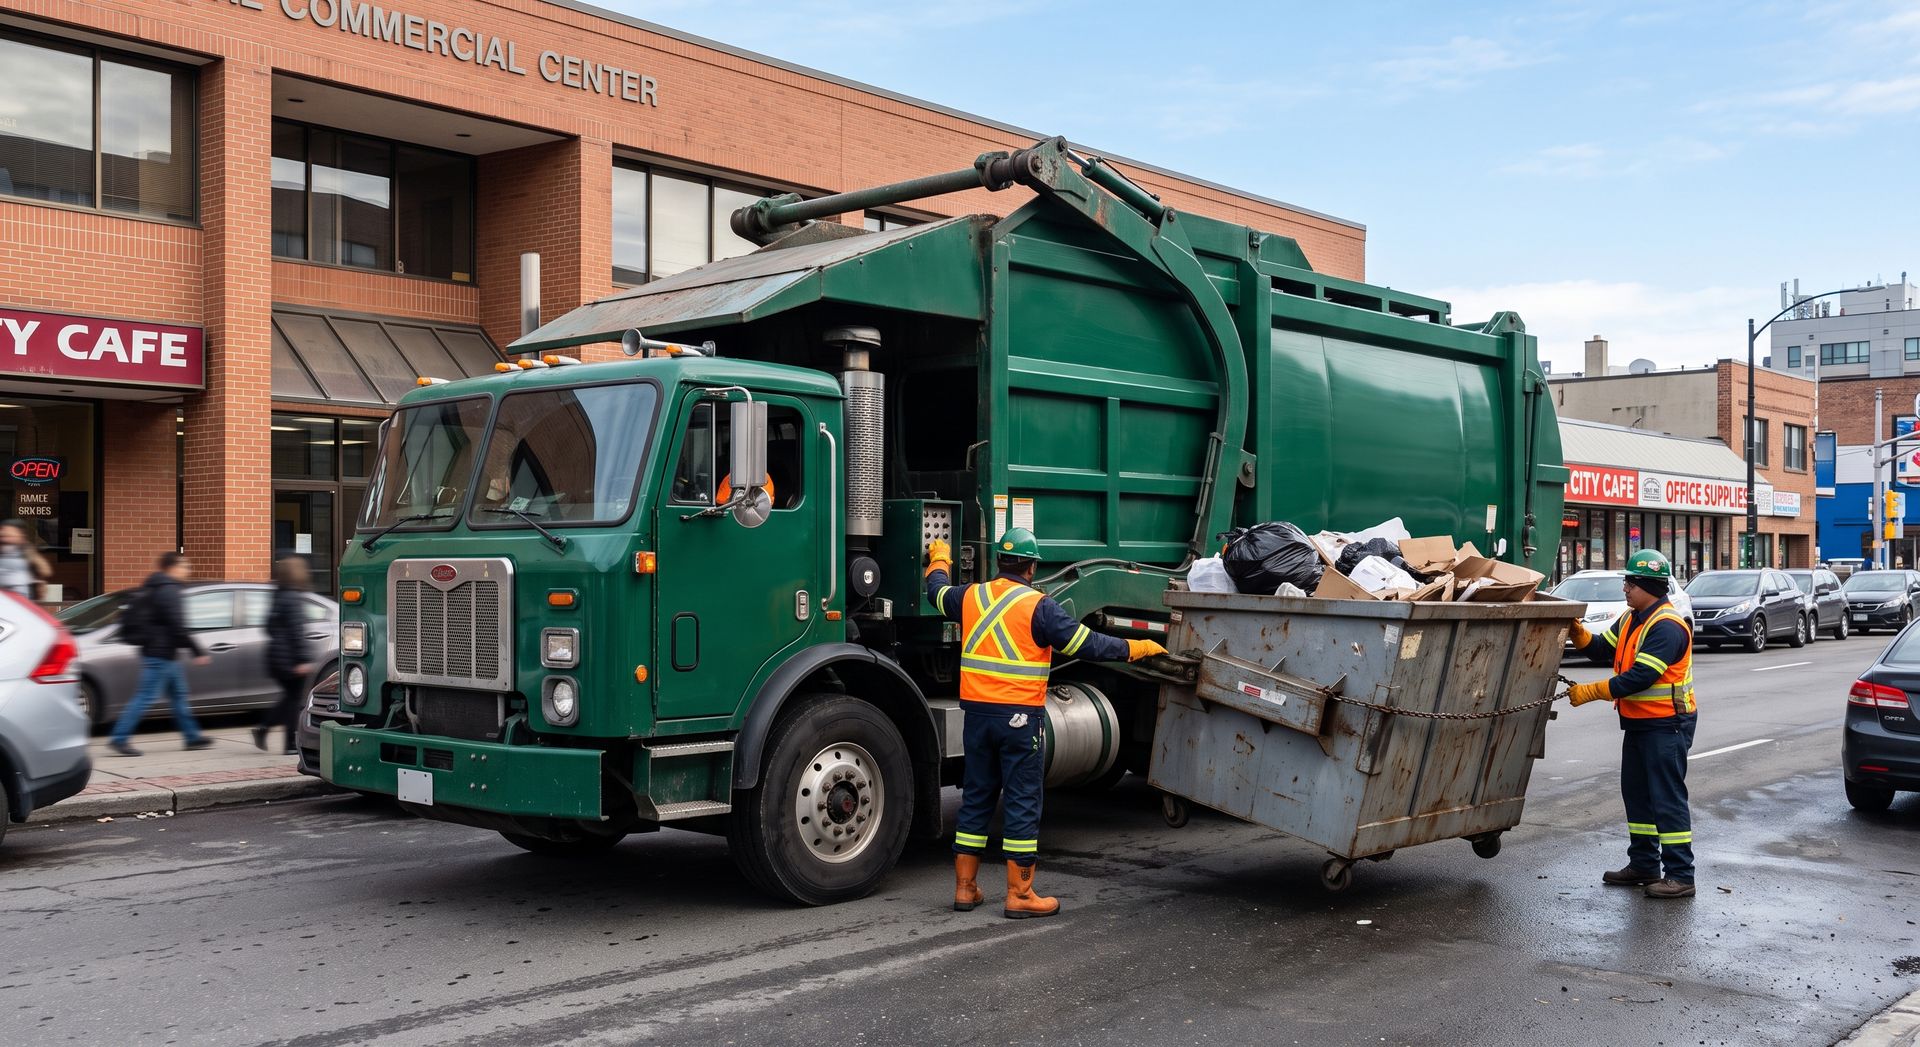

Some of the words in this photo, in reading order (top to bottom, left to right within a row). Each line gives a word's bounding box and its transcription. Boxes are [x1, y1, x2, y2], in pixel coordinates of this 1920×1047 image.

[280, 0, 526, 76] COMMERCIAL
[539, 51, 658, 107] CENTER
[0, 317, 41, 356] Y
[57, 324, 188, 368] CAFE
[11, 461, 60, 478] OPEN
[1570, 470, 1600, 496] CITY
[1602, 473, 1635, 499] CAFE
[1665, 480, 1702, 505] OFFICE
